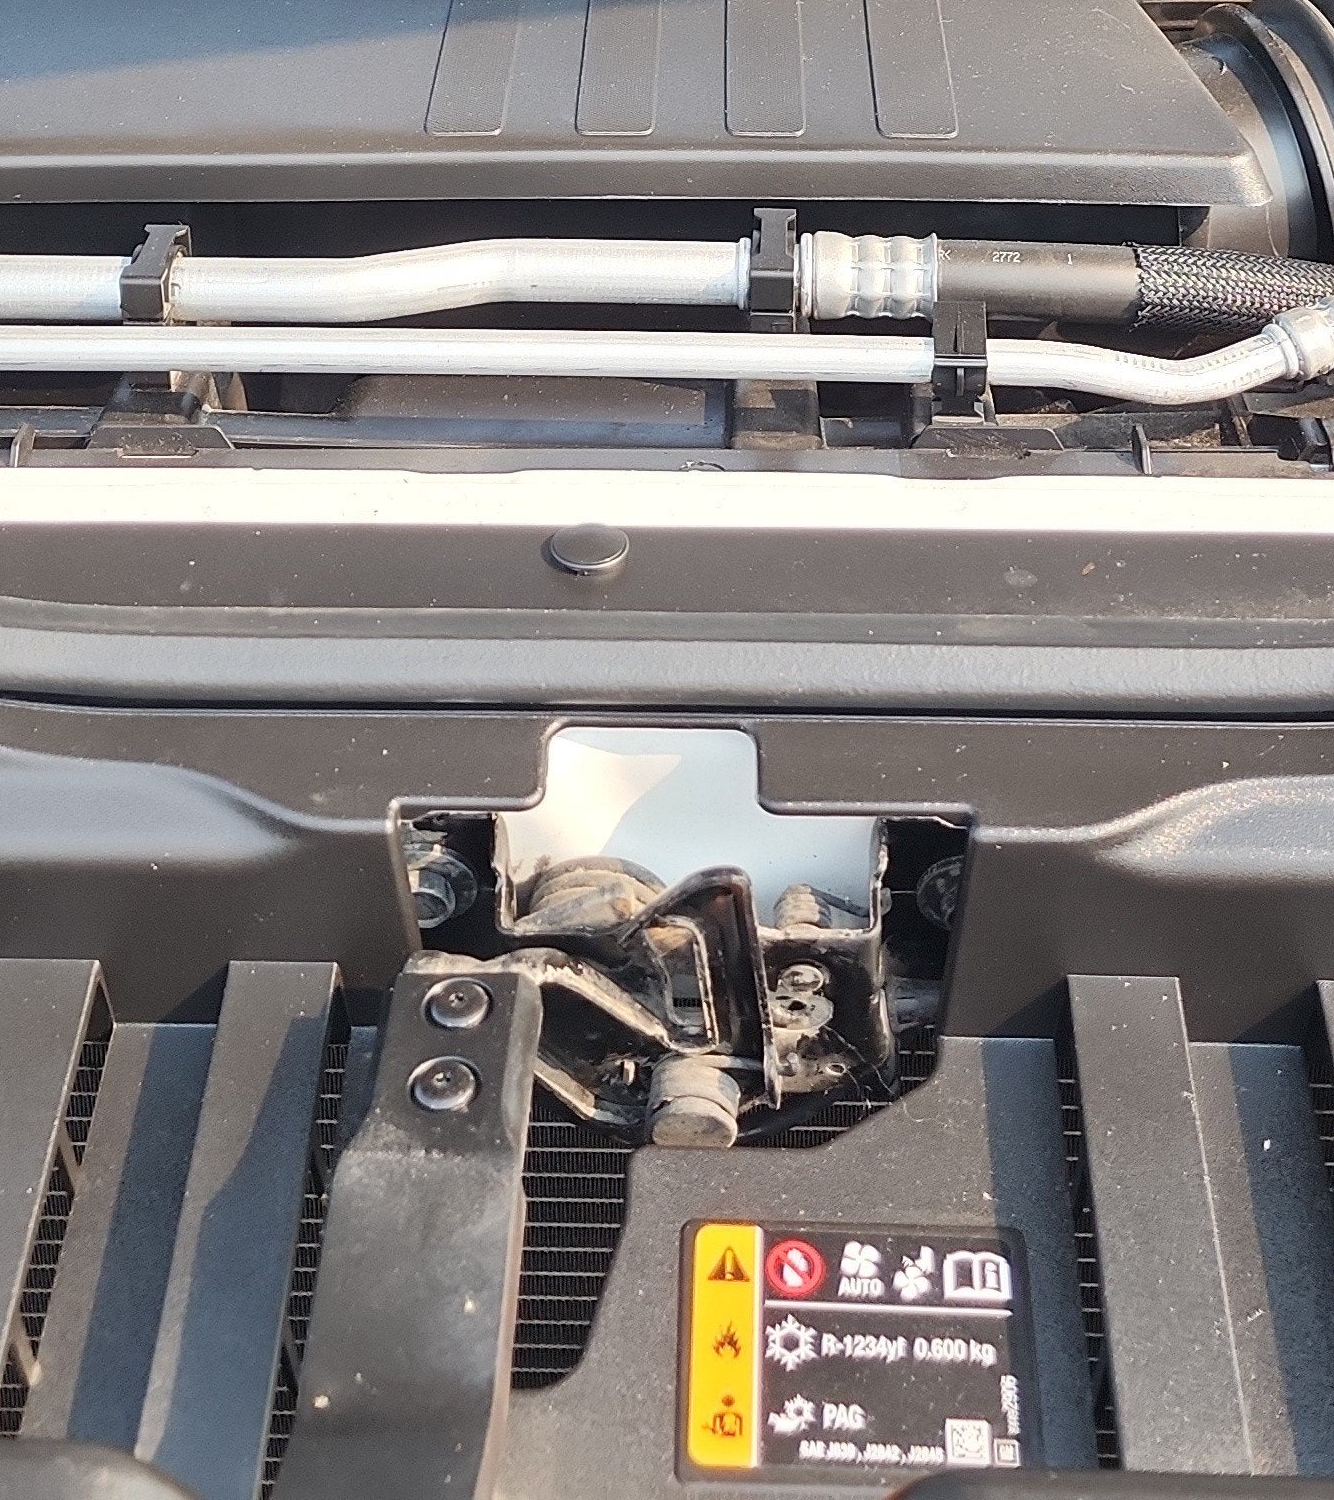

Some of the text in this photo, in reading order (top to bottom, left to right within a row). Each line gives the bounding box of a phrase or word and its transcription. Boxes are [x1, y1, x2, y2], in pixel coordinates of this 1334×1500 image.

[992, 251, 1021, 263] 2772
[838, 1277, 885, 1299] AUTO
[821, 1332, 998, 1368] R-1234yf 0.600 kg
[822, 1403, 866, 1431] PAG
